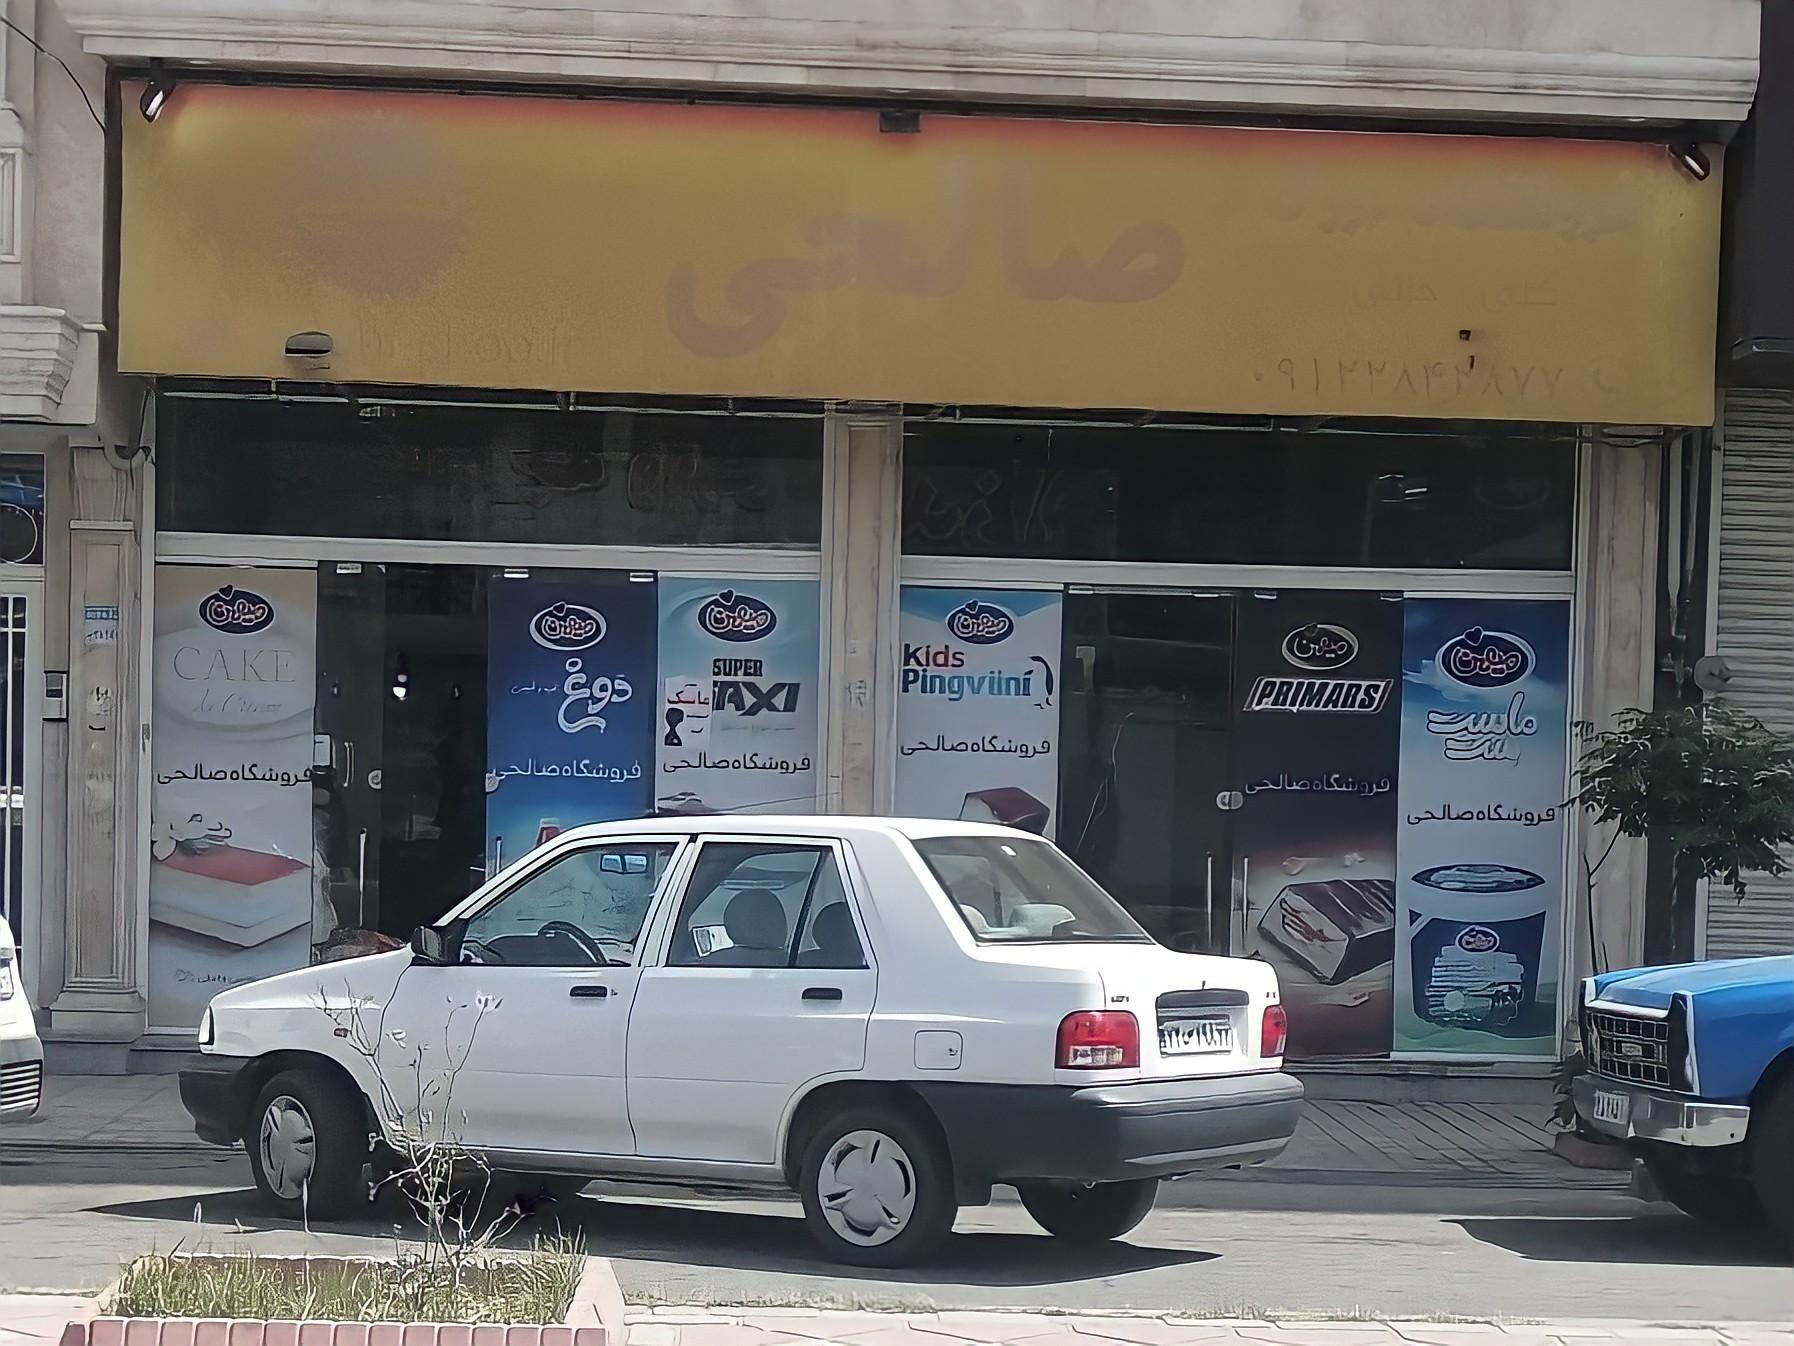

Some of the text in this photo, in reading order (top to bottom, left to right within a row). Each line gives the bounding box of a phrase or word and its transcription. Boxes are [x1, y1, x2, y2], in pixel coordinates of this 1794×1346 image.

[664, 154, 1186, 359] صالحی
[173, 646, 297, 683] CAKE
[903, 643, 965, 668] Kids
[712, 658, 763, 678] SUPER
[557, 657, 634, 735] دوغ
[901, 668, 1035, 702] Pingviini
[900, 735, 1051, 758] فروشگاه صالحی
[157, 763, 312, 787] فروشگاه صالحی
[491, 757, 642, 783] فروشگاه صالحی
[663, 751, 811, 775] فروشگاه صالحی
[1245, 773, 1391, 796] فروشگاه صالحی
[1407, 803, 1556, 827] فروشگاه صالحی
